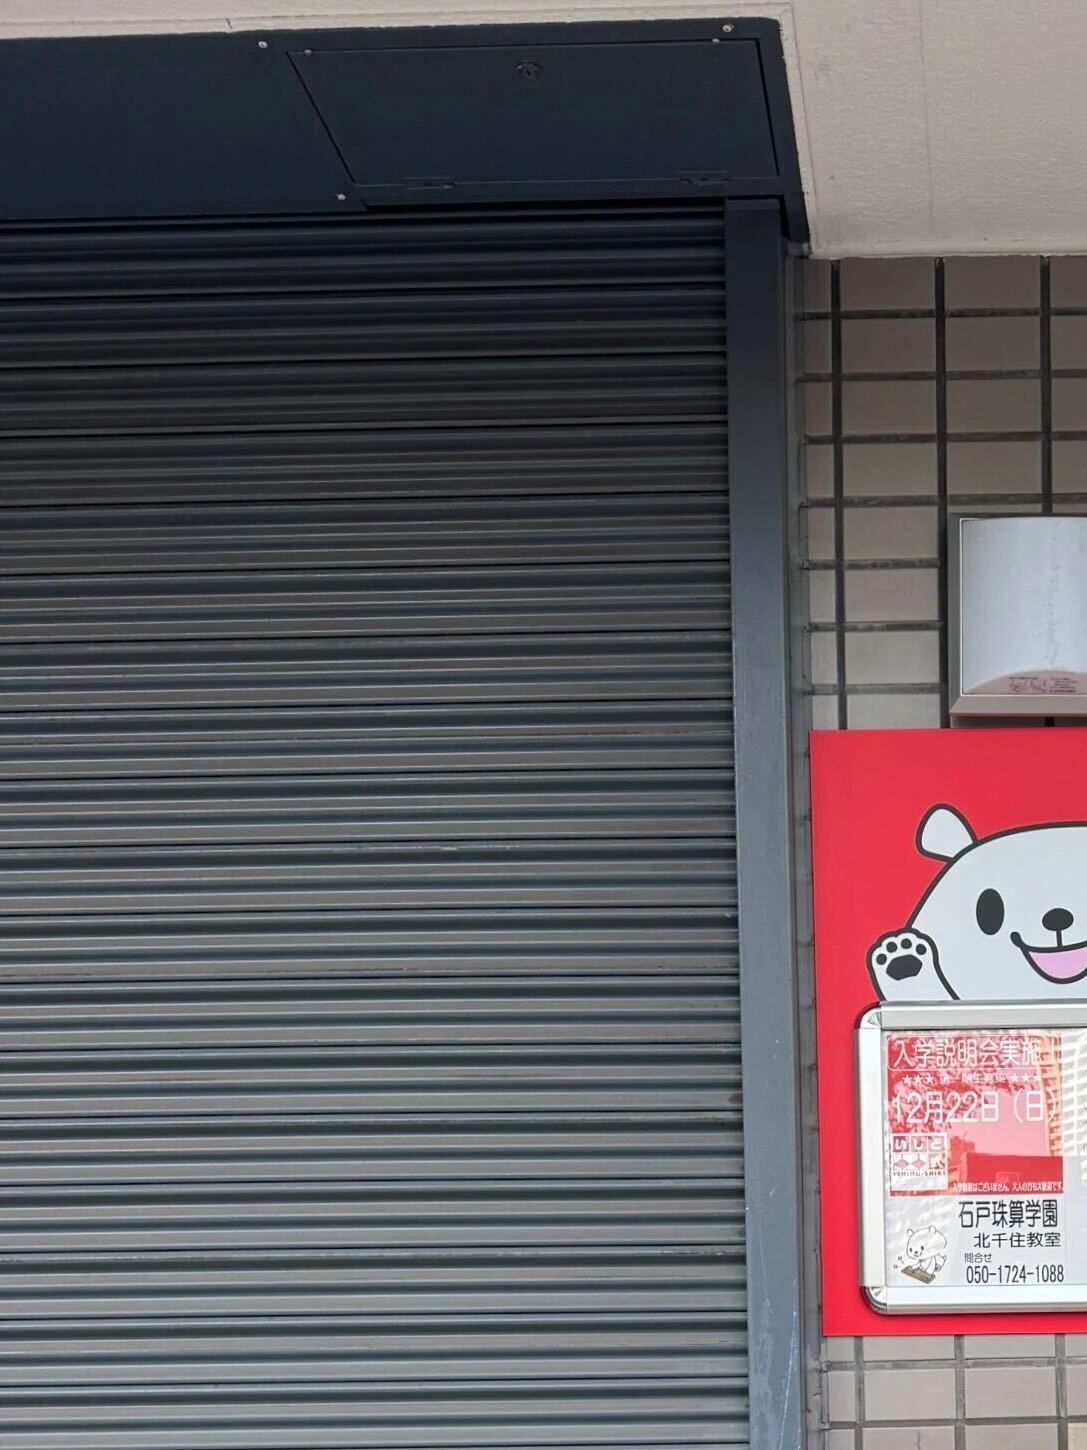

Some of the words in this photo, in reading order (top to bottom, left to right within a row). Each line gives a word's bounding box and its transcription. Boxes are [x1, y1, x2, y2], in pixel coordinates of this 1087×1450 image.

[958, 1199, 1058, 1228] 石戸珠算学園
[973, 1232, 1062, 1249] 北千住教室
[964, 1253, 993, 1263] 問合せ
[966, 1265, 1065, 1284] 050-1724-1088
